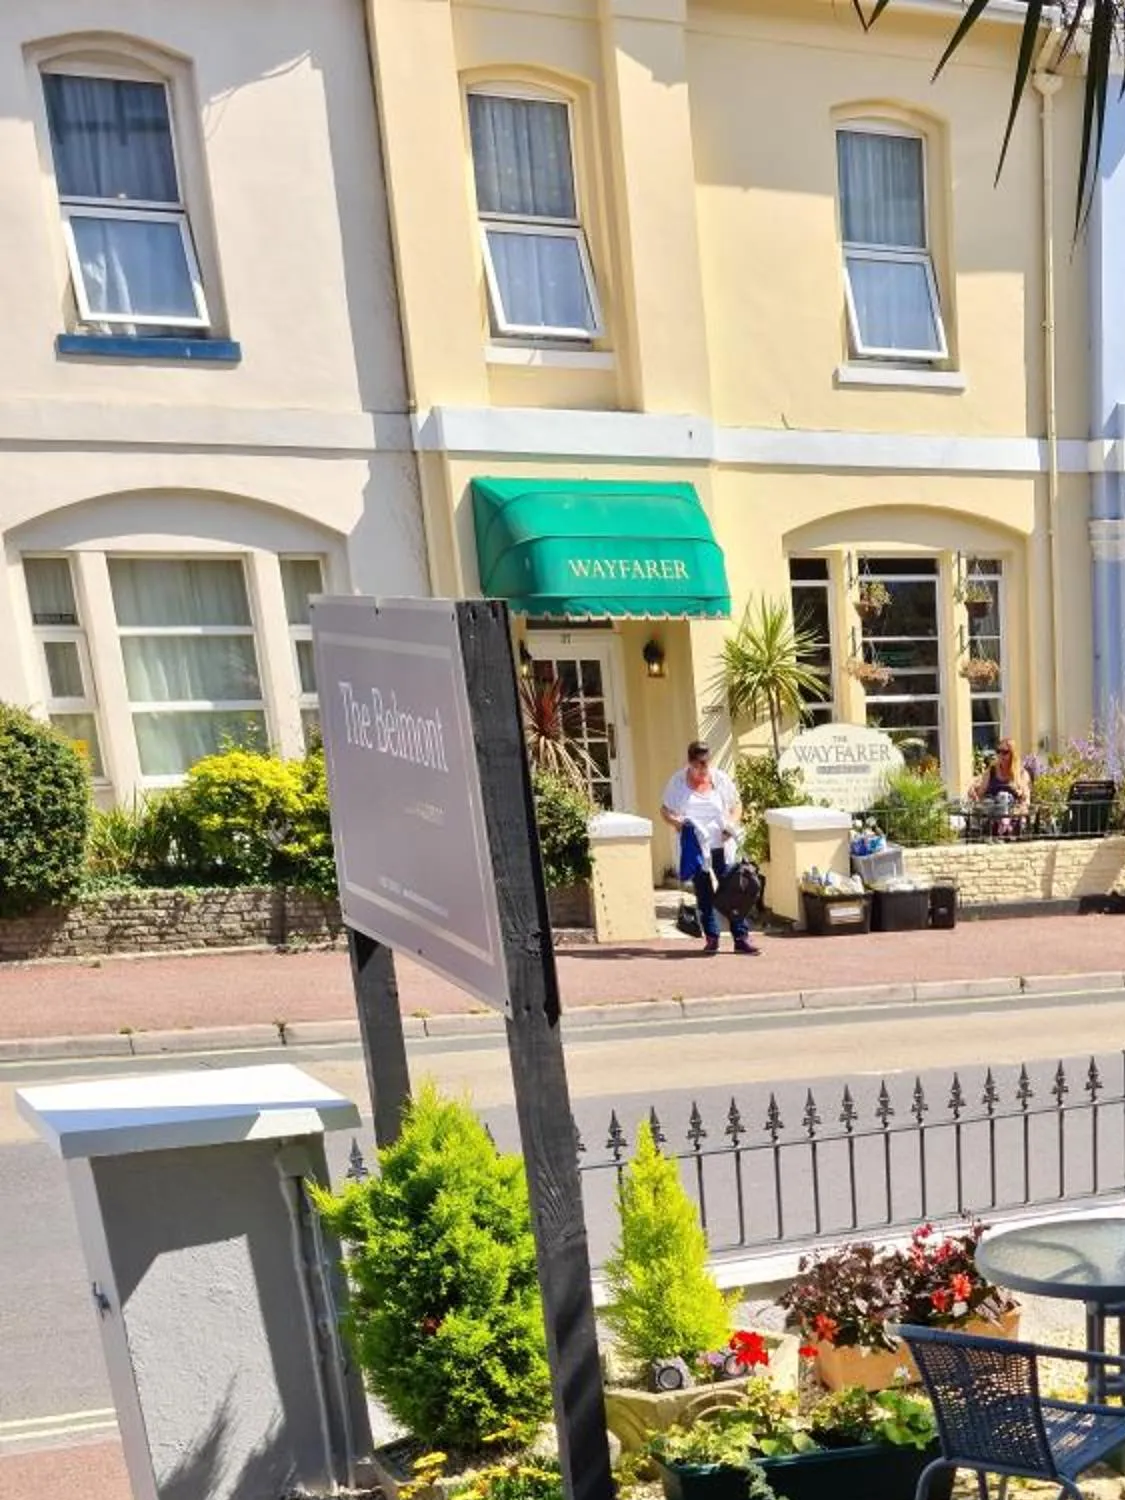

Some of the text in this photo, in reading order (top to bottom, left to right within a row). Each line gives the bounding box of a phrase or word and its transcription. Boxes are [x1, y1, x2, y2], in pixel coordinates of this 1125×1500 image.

[567, 559, 689, 580] WAYFARER
[338, 681, 449, 774] The Belmont
[793, 743, 891, 764] WAYFARER
